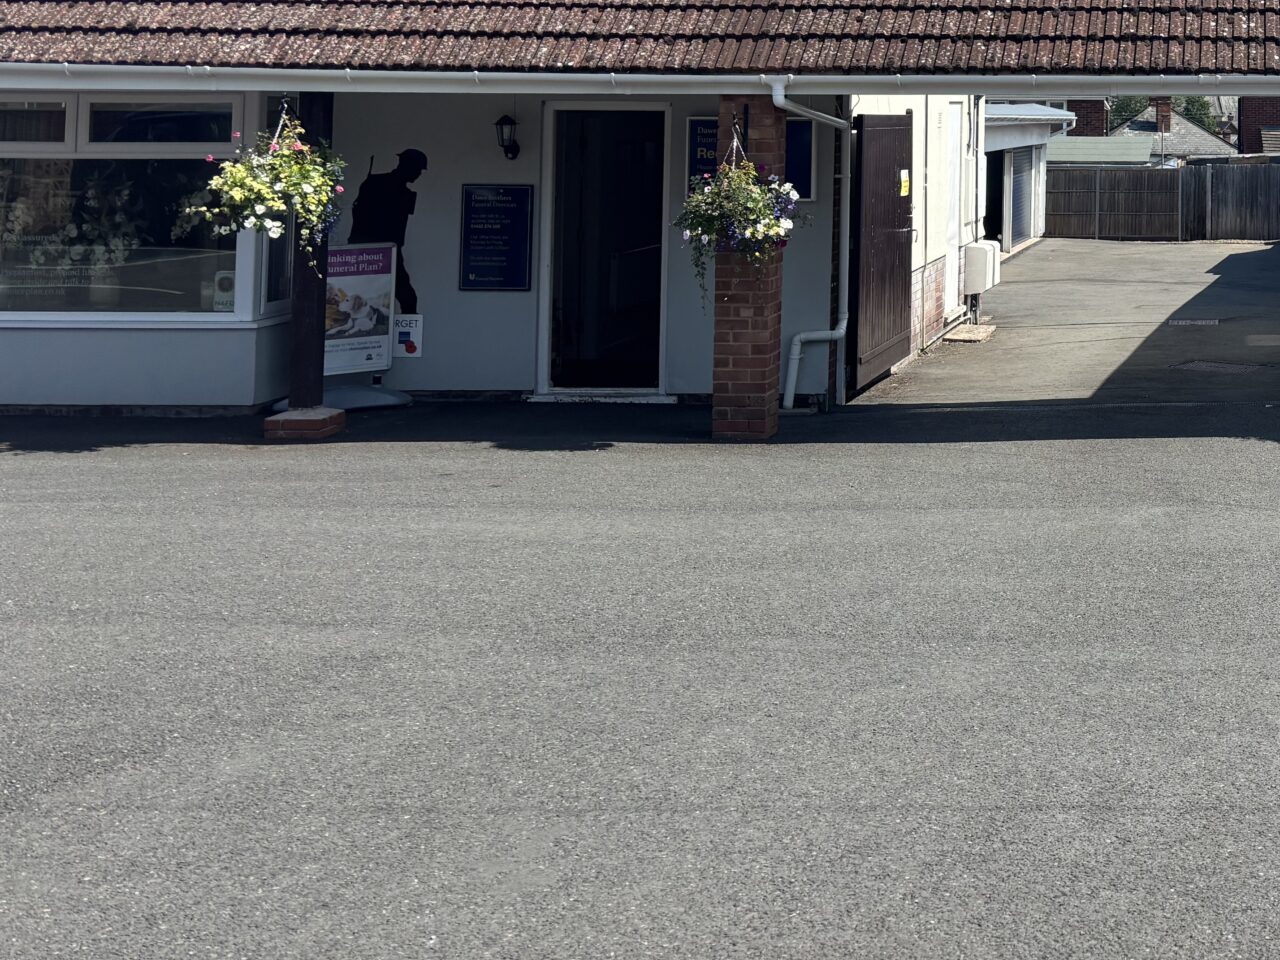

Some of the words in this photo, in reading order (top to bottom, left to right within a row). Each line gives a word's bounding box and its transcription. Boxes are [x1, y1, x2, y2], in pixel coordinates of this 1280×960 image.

[328, 254, 357, 264] inking
[358, 252, 383, 261] about
[328, 263, 357, 273] uneral
[359, 262, 383, 272] Plan?
[393, 319, 420, 329] RGET
